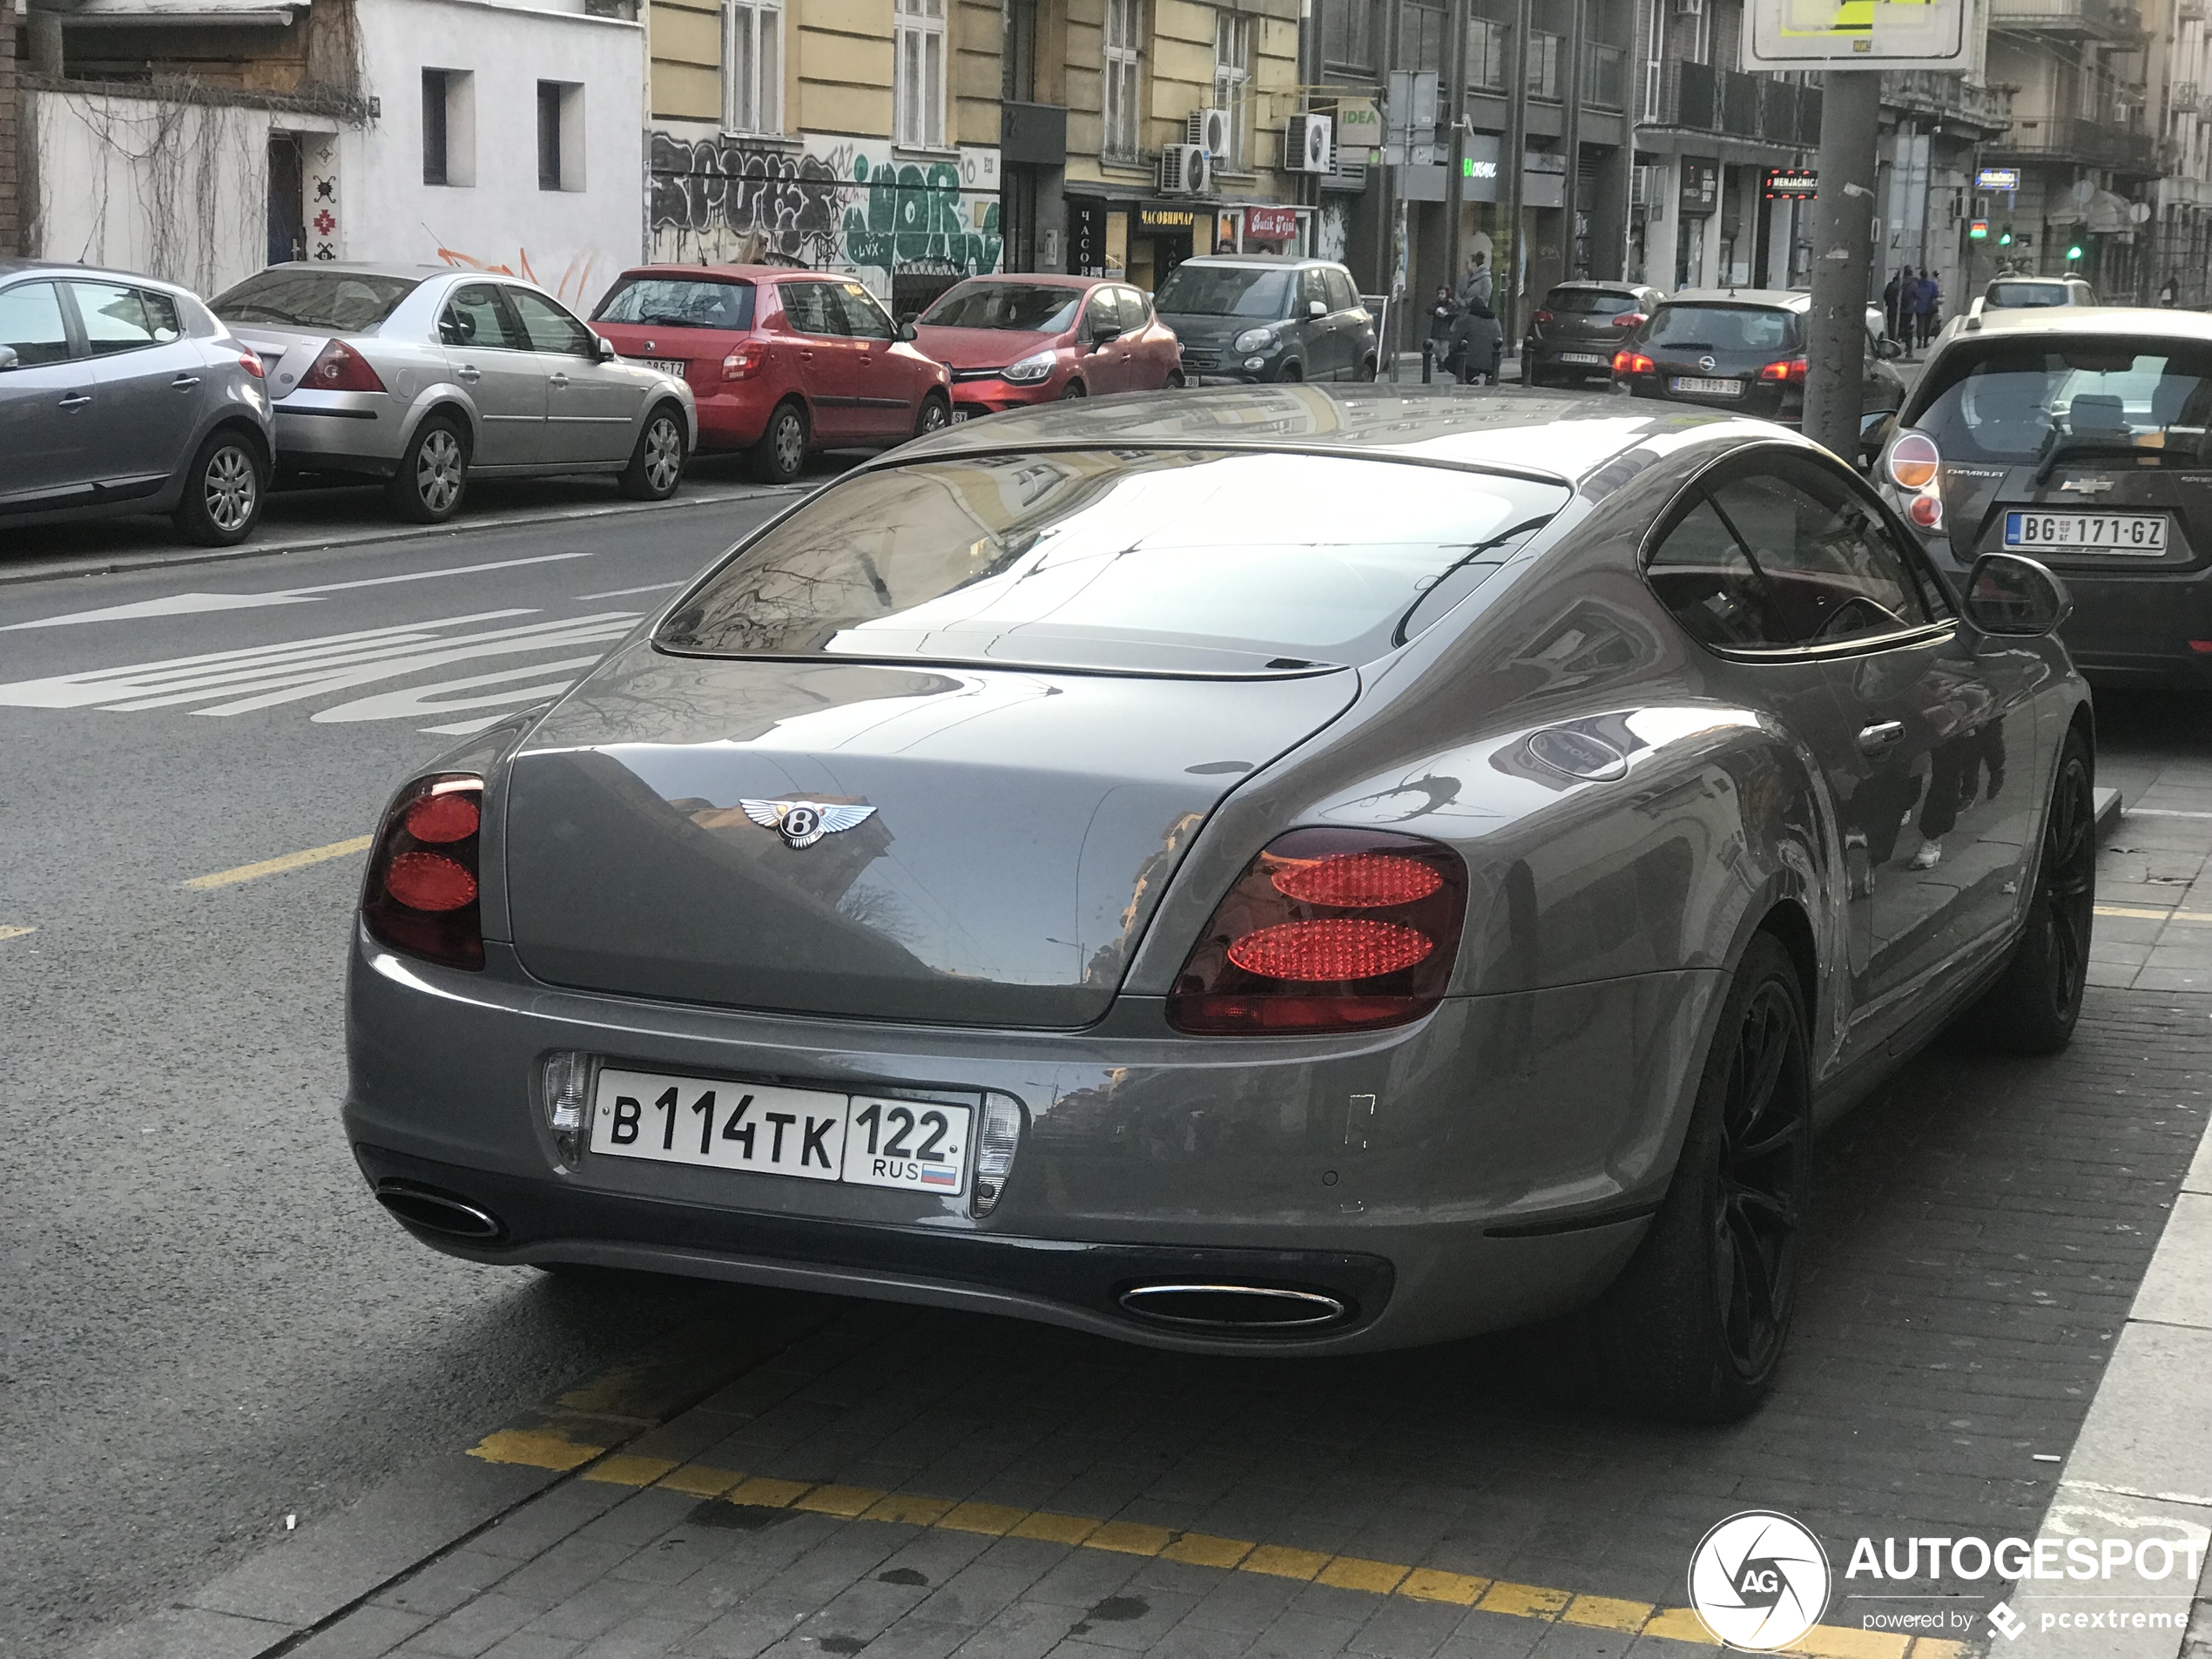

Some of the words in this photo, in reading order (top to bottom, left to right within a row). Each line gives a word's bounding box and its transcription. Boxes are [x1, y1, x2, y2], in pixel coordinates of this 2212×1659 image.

[1464, 158, 1473, 177] EA
[1141, 210, 1194, 226] ЧАСОВНИЧАР
[2025, 517, 2055, 541] BG
[855, 1103, 948, 1162] 122
[873, 1158, 919, 1181] RUS
